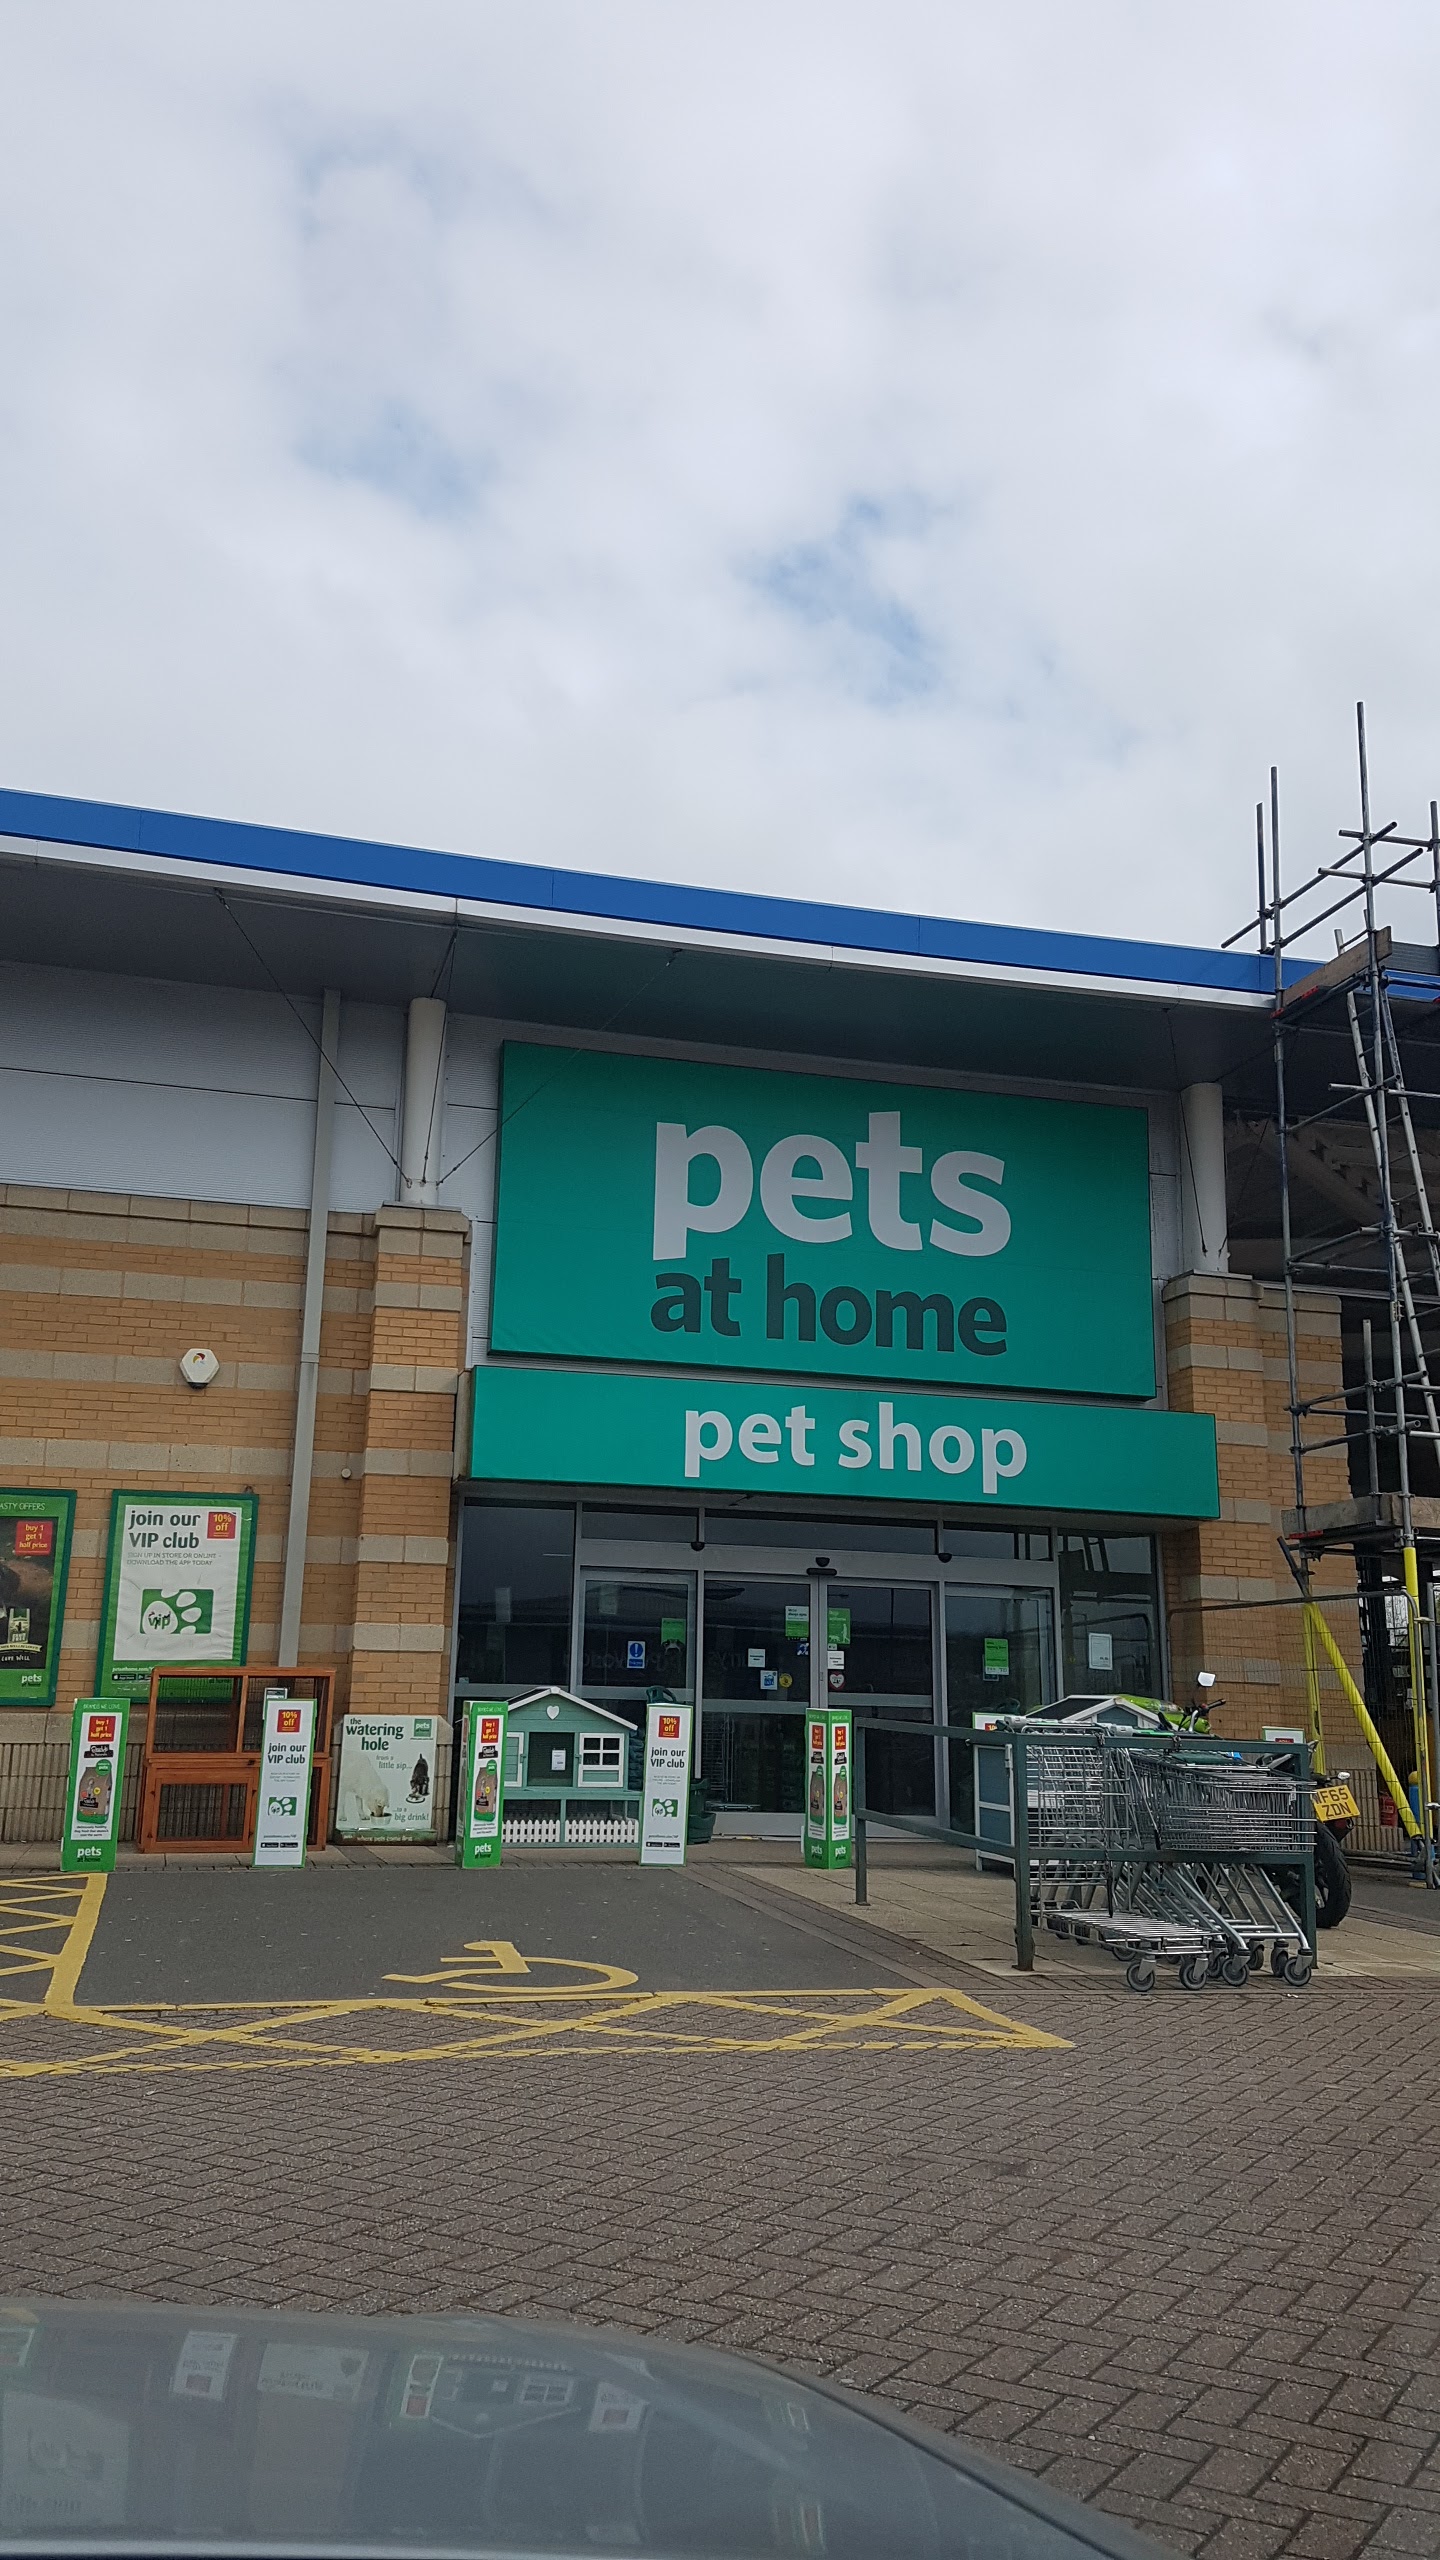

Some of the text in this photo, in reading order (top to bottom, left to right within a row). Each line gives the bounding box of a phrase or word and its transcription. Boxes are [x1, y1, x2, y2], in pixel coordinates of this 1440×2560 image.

[653, 1111, 1012, 1261] pets
[650, 1253, 1008, 1357] at home
[684, 1402, 1028, 1494] pet shop
[19, 1502, 46, 1511] OFFERS
[128, 1510, 201, 1530] join our
[213, 1513, 232, 1523] 10%
[25, 1524, 38, 1532] buy
[215, 1522, 229, 1531] off
[25, 1533, 37, 1541] get
[129, 1531, 200, 1549] VIP club
[32, 1542, 48, 1550] price
[148, 1613, 171, 1629] vip
[21, 1673, 42, 1684] pets
[281, 1711, 298, 1719] 10%
[283, 1718, 295, 1726] off
[415, 1722, 430, 1730] pets
[662, 1717, 677, 1725] 10%
[346, 1723, 404, 1740] watering
[664, 1724, 675, 1732] off
[268, 1742, 307, 1755] join our
[361, 1736, 390, 1750] hole
[650, 1746, 686, 1758] join our
[267, 1754, 306, 1764] VIP club
[650, 1758, 685, 1768] VIP club
[378, 1761, 395, 1769] little
[1321, 1802, 1352, 1818] ZDN
[394, 1812, 430, 1823] big drink!
[77, 1846, 102, 1858] pets
[474, 1843, 492, 1855] pets
[835, 1845, 847, 1857] pets
